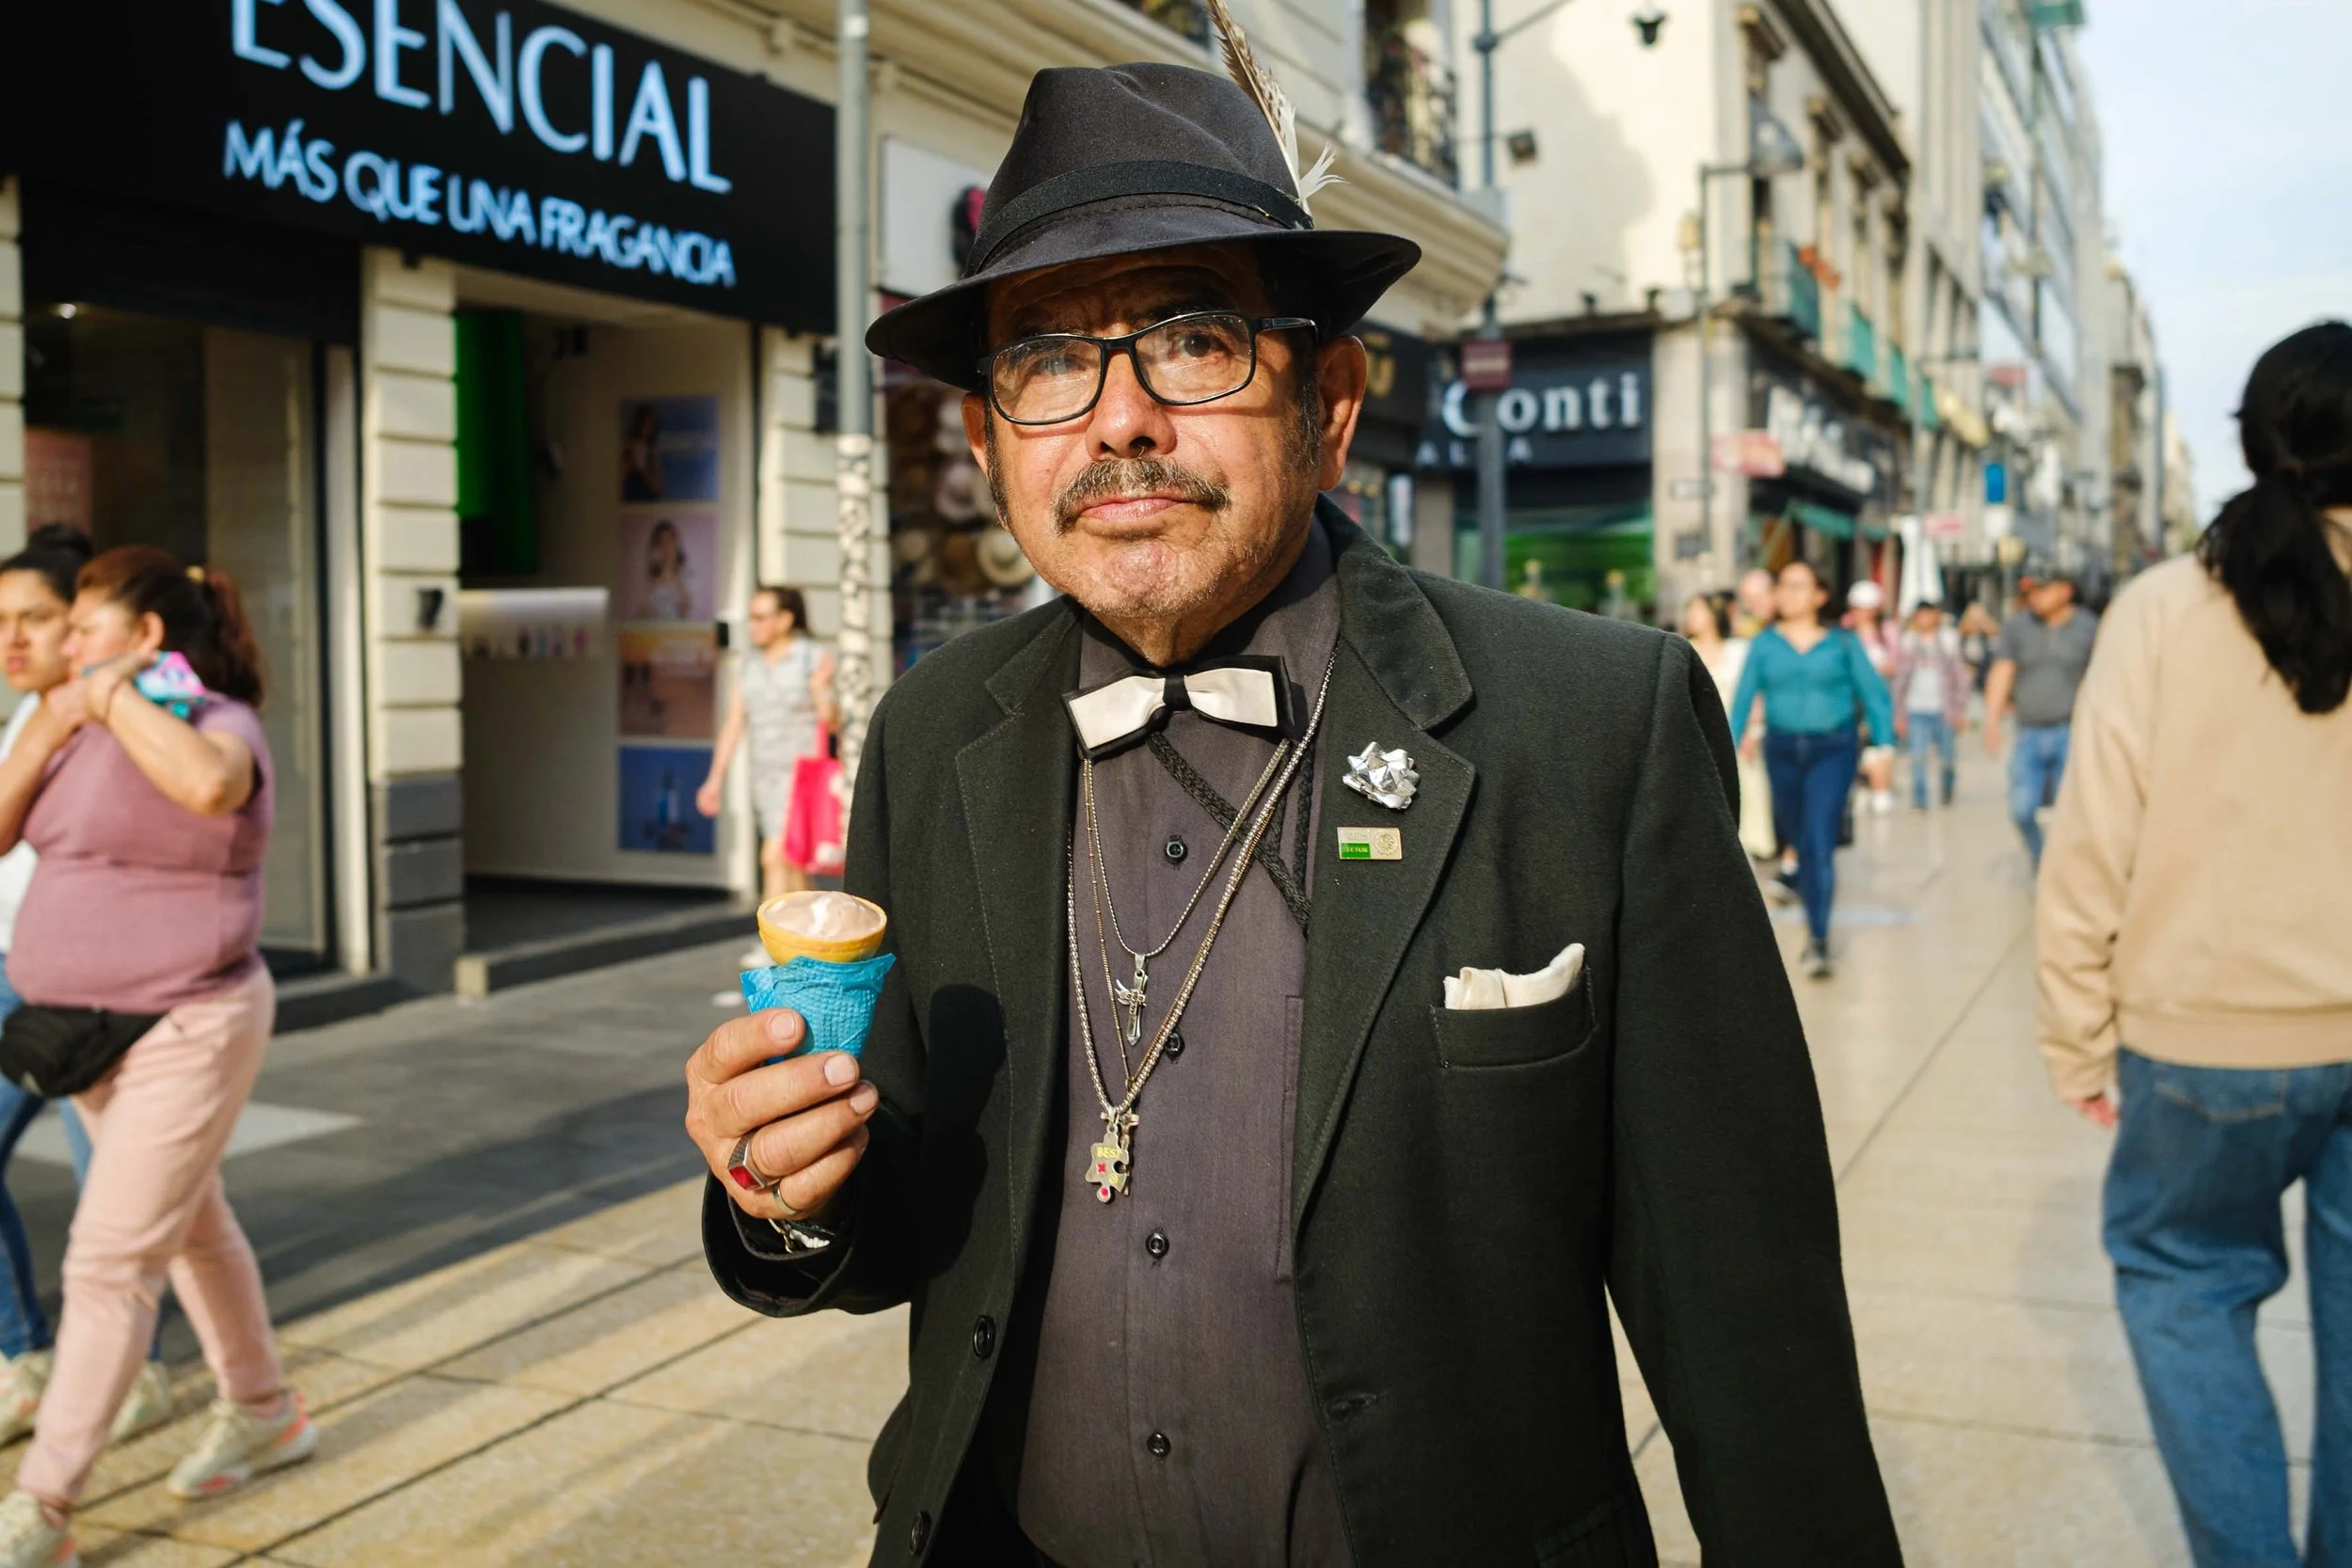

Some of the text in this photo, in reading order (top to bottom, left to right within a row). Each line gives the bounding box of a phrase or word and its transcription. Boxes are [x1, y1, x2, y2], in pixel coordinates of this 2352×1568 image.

[230, 0, 732, 195] ESENCIAL
[224, 119, 736, 286] MÁS QUE UNA FRAGANCIA
[1440, 372, 1643, 438] Conti
